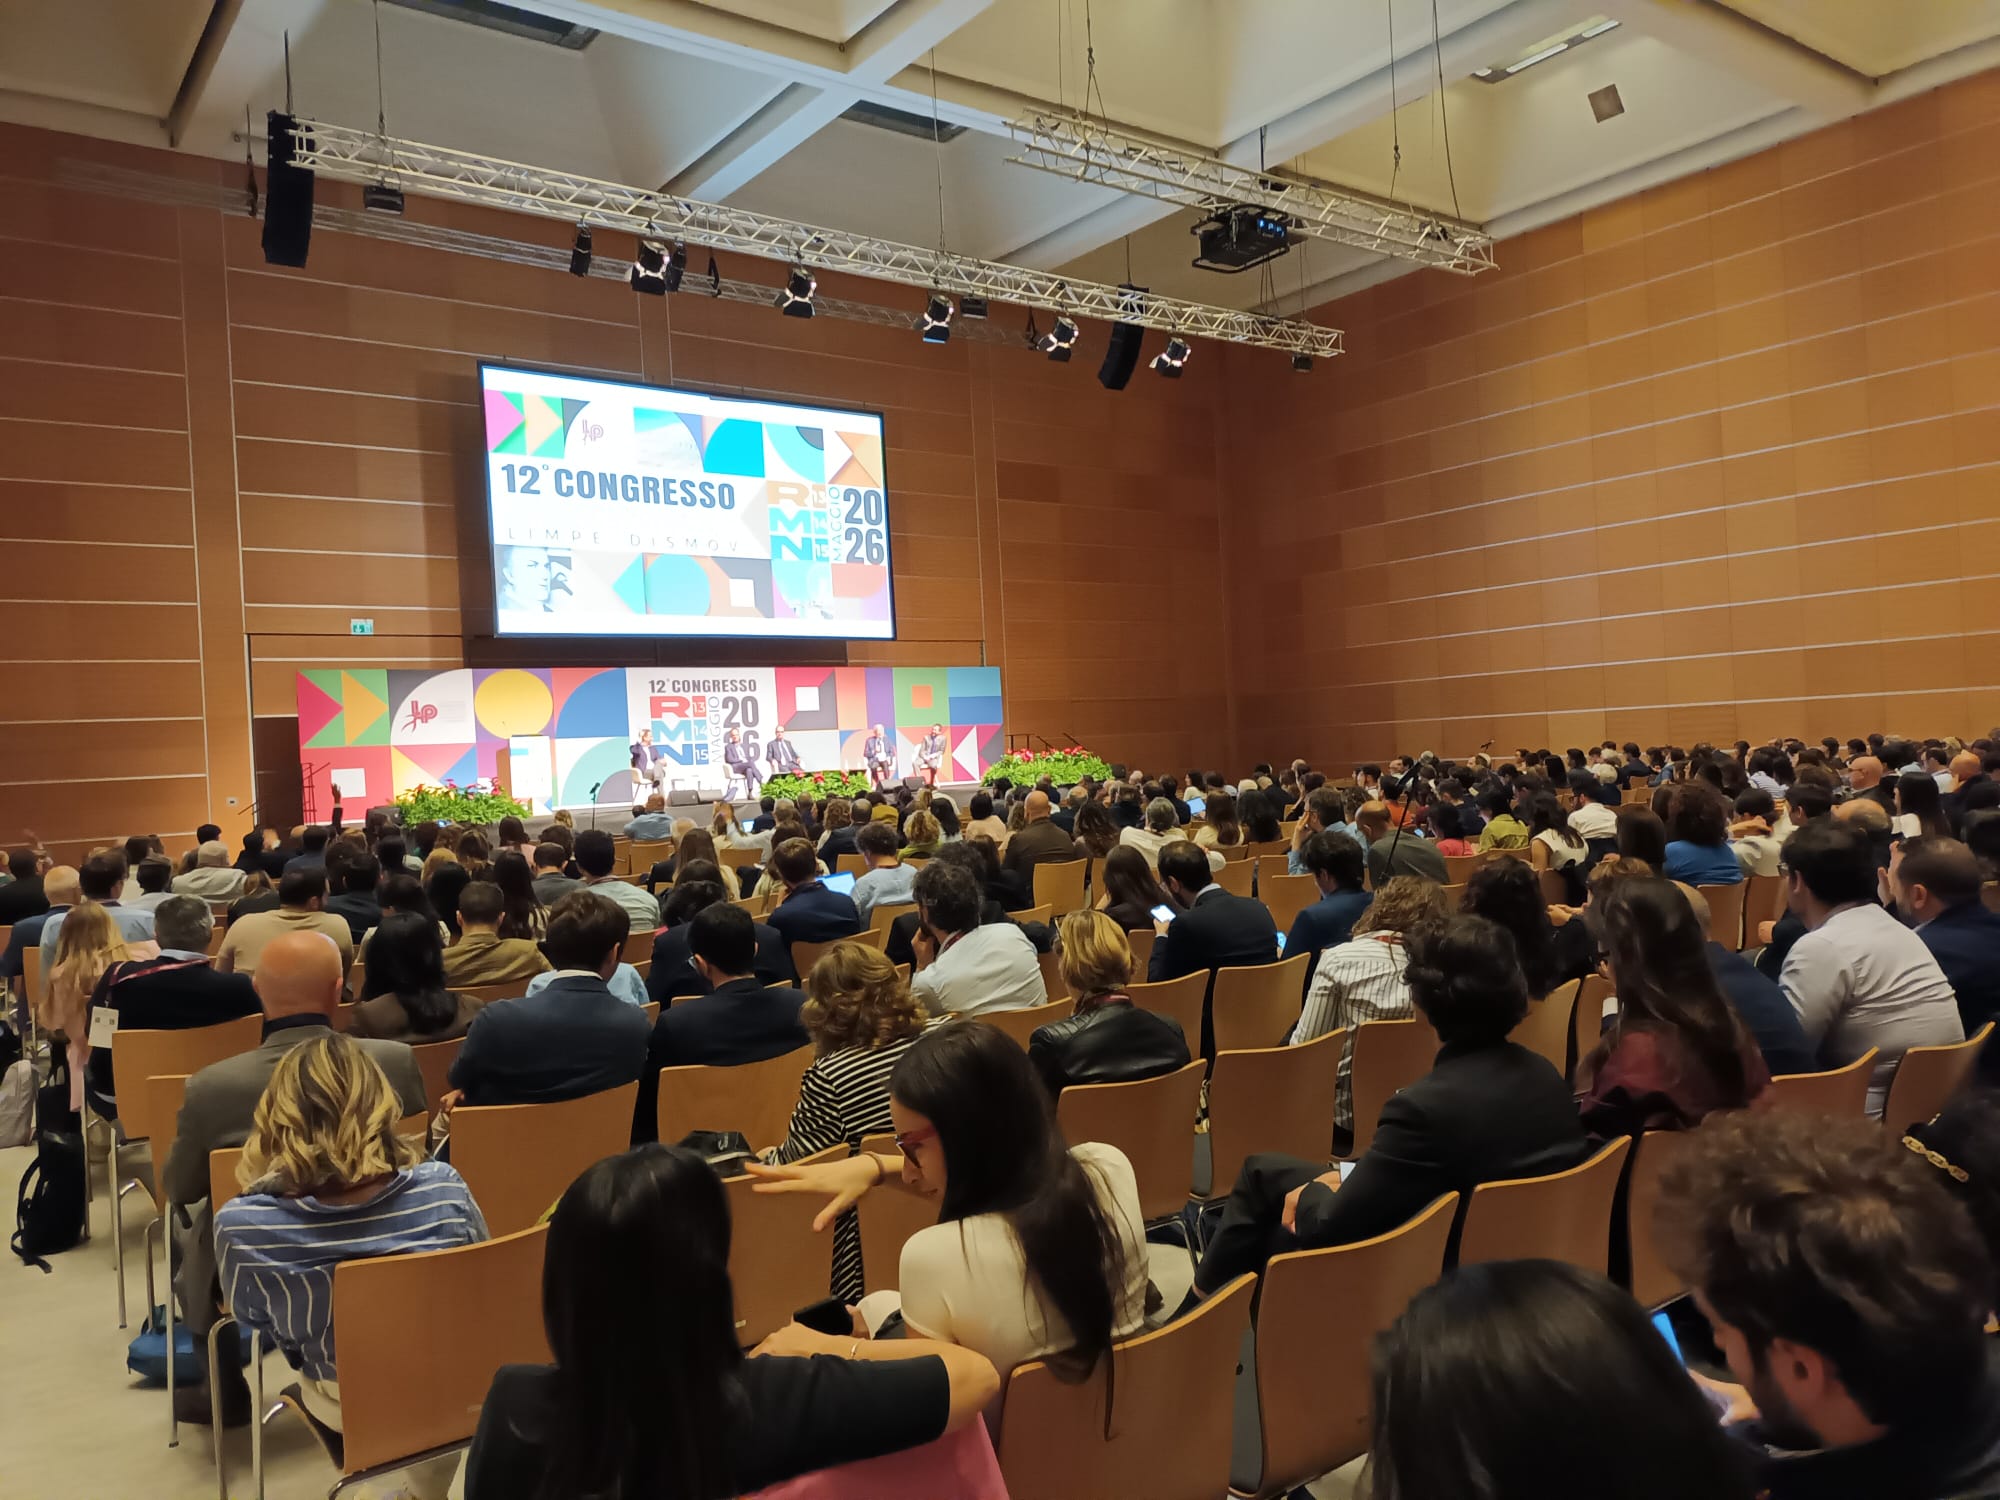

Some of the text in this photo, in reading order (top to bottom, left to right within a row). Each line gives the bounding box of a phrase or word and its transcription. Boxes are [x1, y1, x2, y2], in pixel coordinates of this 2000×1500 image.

[554, 467, 737, 511] CONGRESSO
[843, 487, 883, 526] 20
[508, 527, 739, 552] LIMPE DISMOV
[844, 527, 885, 565] 26
[672, 679, 757, 694] CONGRESSO
[708, 695, 722, 763] MAGGIO
[722, 695, 760, 728] 20
[723, 730, 761, 763] 6
